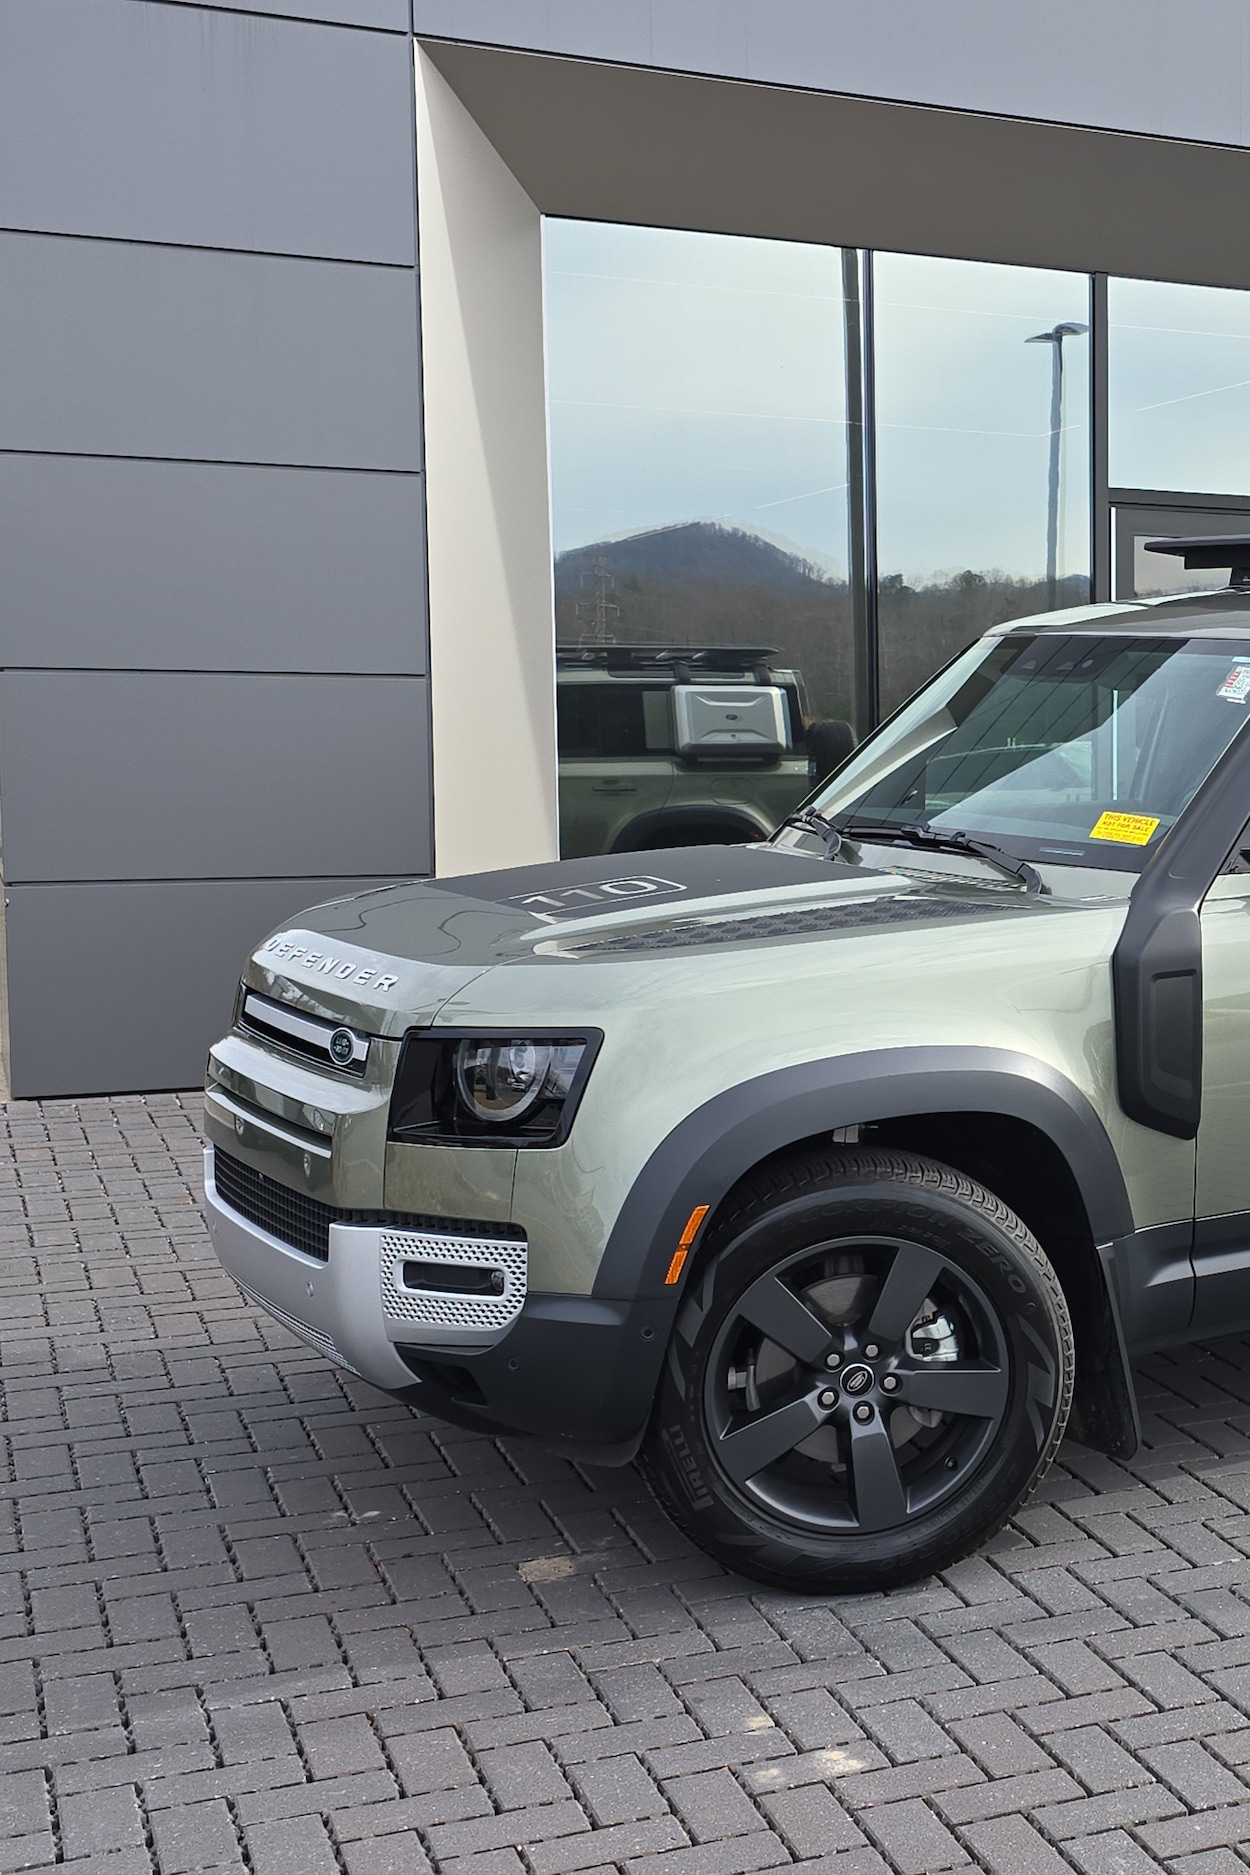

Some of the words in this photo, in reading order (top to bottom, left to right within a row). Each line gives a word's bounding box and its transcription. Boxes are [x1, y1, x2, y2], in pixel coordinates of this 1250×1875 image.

[521, 880, 658, 907] 110
[264, 938, 399, 992] DEFENDER
[956, 1229, 1027, 1294] ZERO
[662, 1424, 714, 1511] PIRELLI
